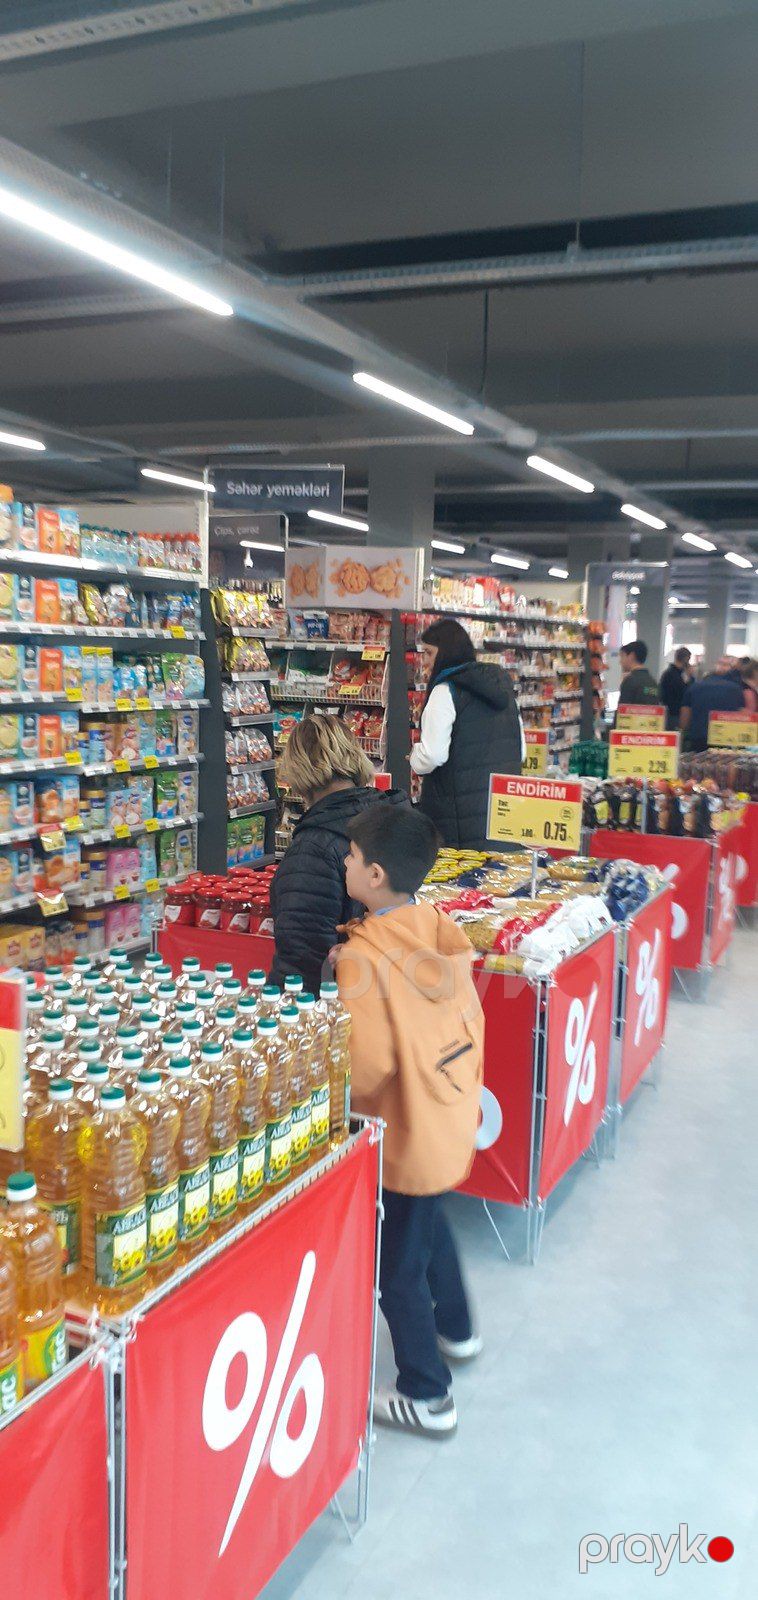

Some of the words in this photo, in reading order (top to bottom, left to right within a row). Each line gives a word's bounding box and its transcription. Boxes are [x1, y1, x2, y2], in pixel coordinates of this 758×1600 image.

[227, 481, 263, 495] Səhər
[267, 482, 330, 498] yeməkləri
[506, 781, 568, 799] ENDİRİM
[543, 821, 568, 841] 0.75
